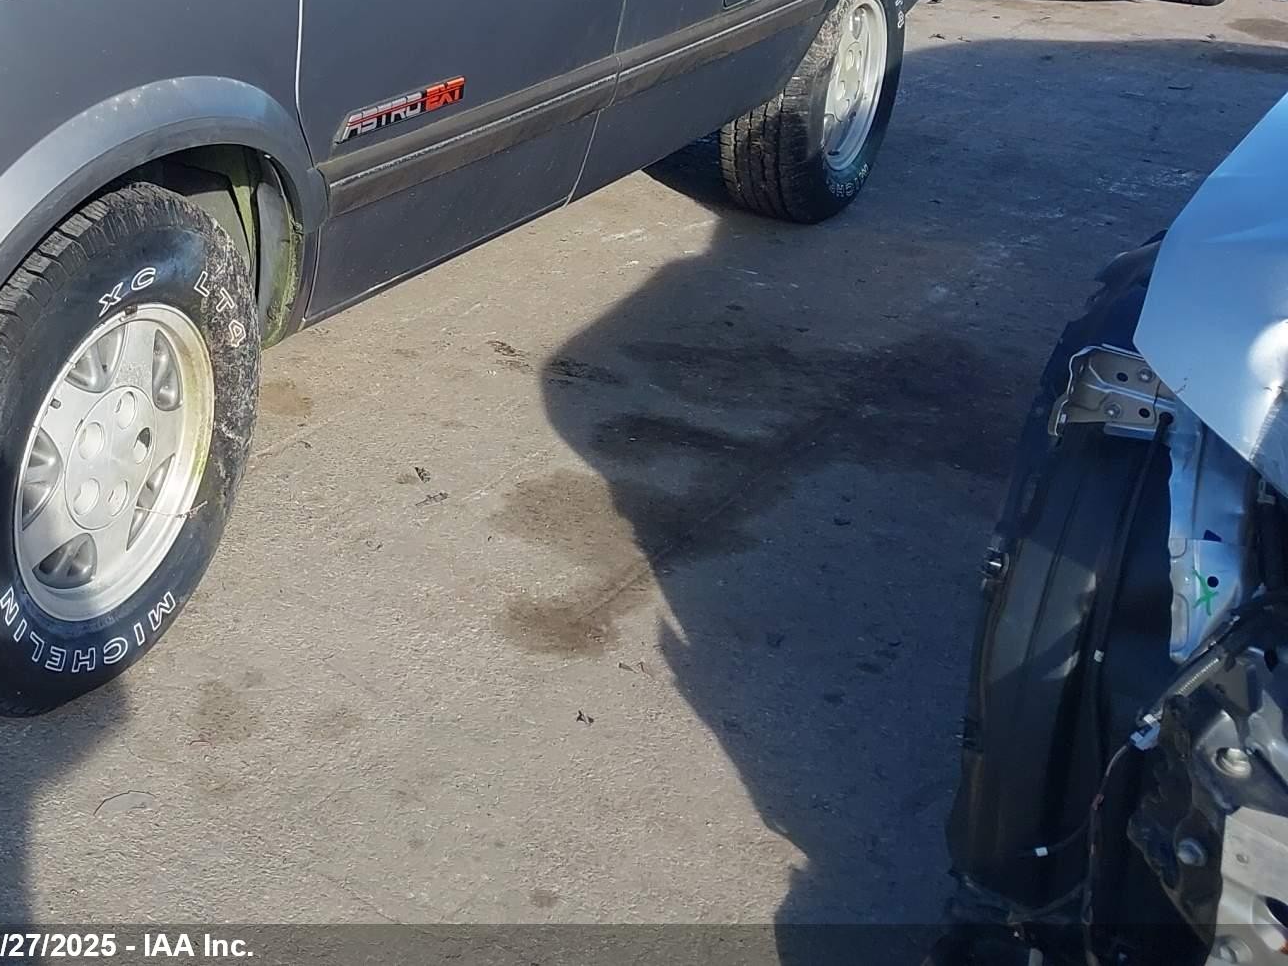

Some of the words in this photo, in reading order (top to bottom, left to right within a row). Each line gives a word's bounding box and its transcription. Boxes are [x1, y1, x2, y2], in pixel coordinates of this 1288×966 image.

[335, 91, 422, 145] ASTRO
[98, 266, 157, 318] XC
[0, 585, 177, 673] MICHELIN
